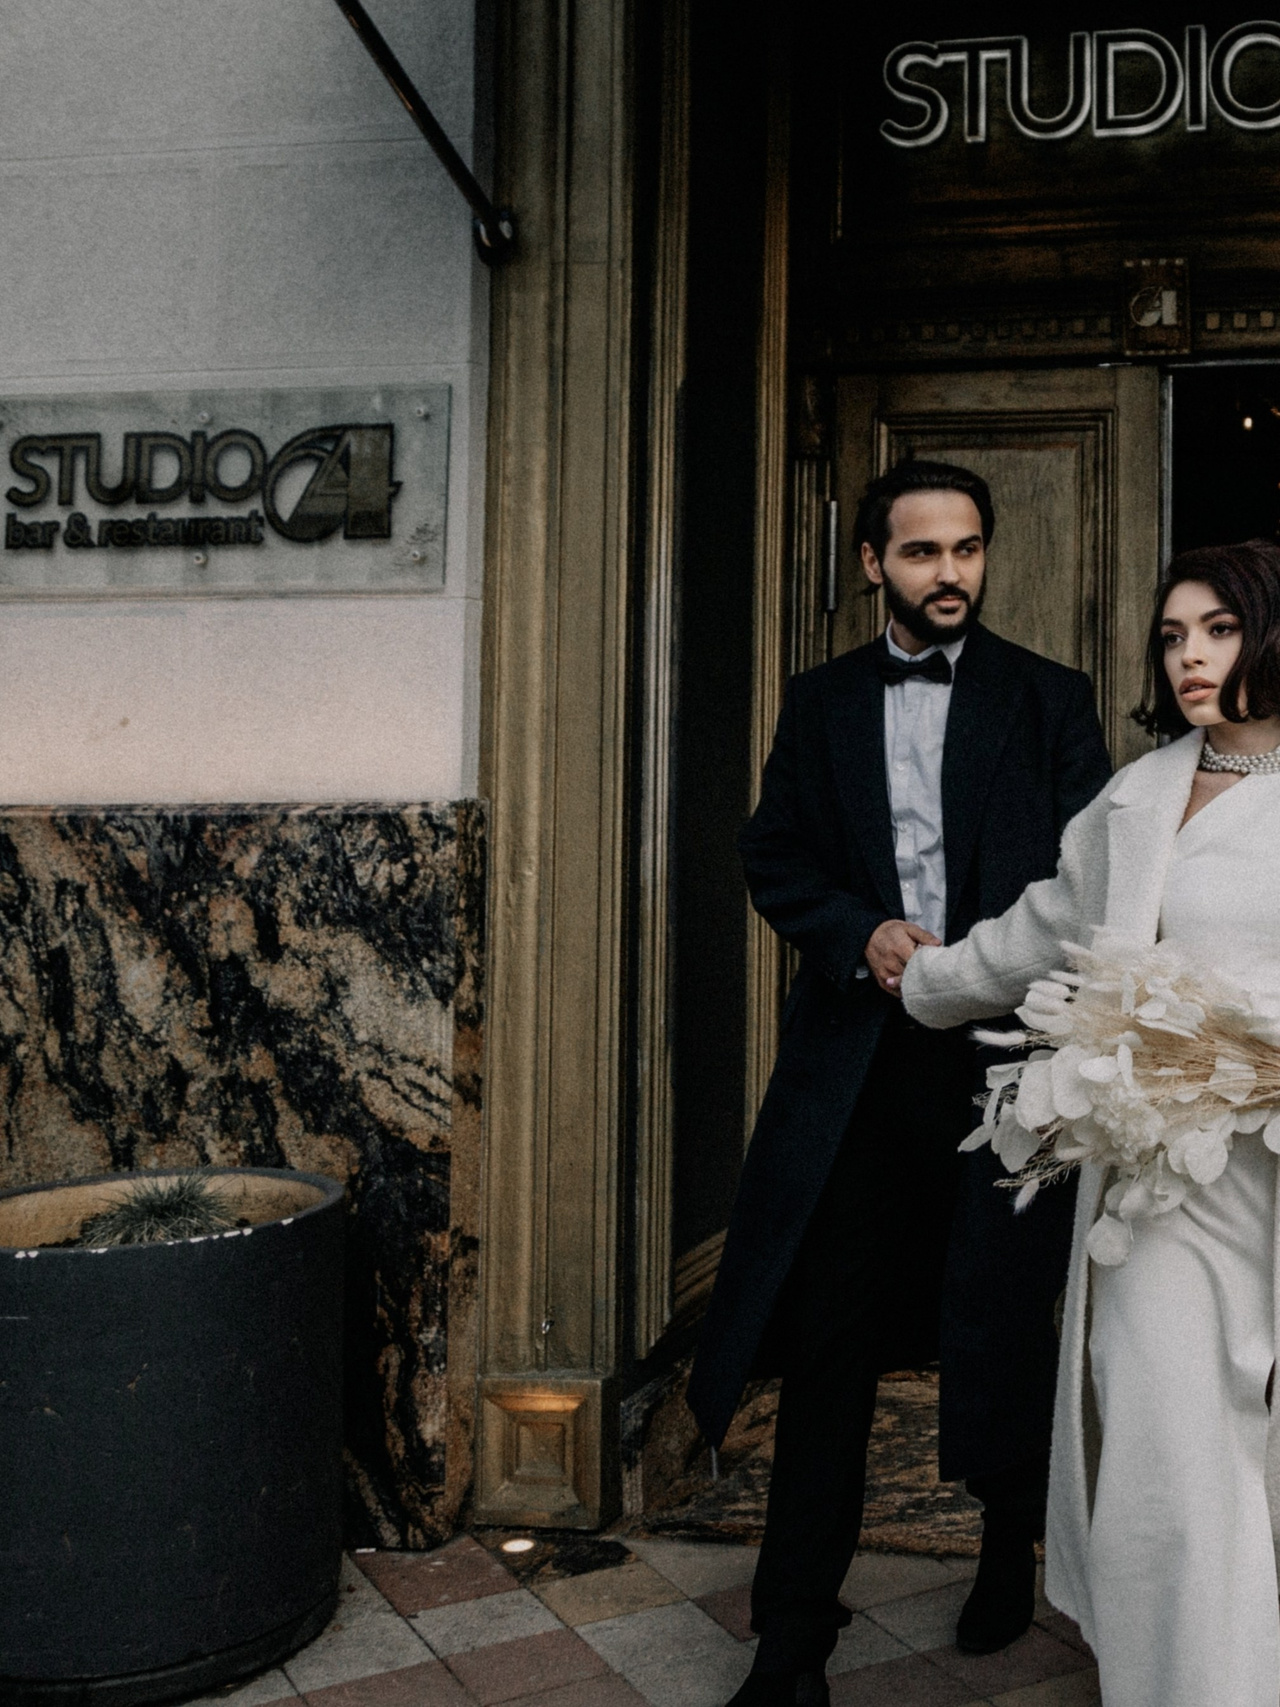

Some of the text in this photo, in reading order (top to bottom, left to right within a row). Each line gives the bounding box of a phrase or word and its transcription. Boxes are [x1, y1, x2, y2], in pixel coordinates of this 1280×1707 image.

[5, 510, 265, 550] bar & restaurant
